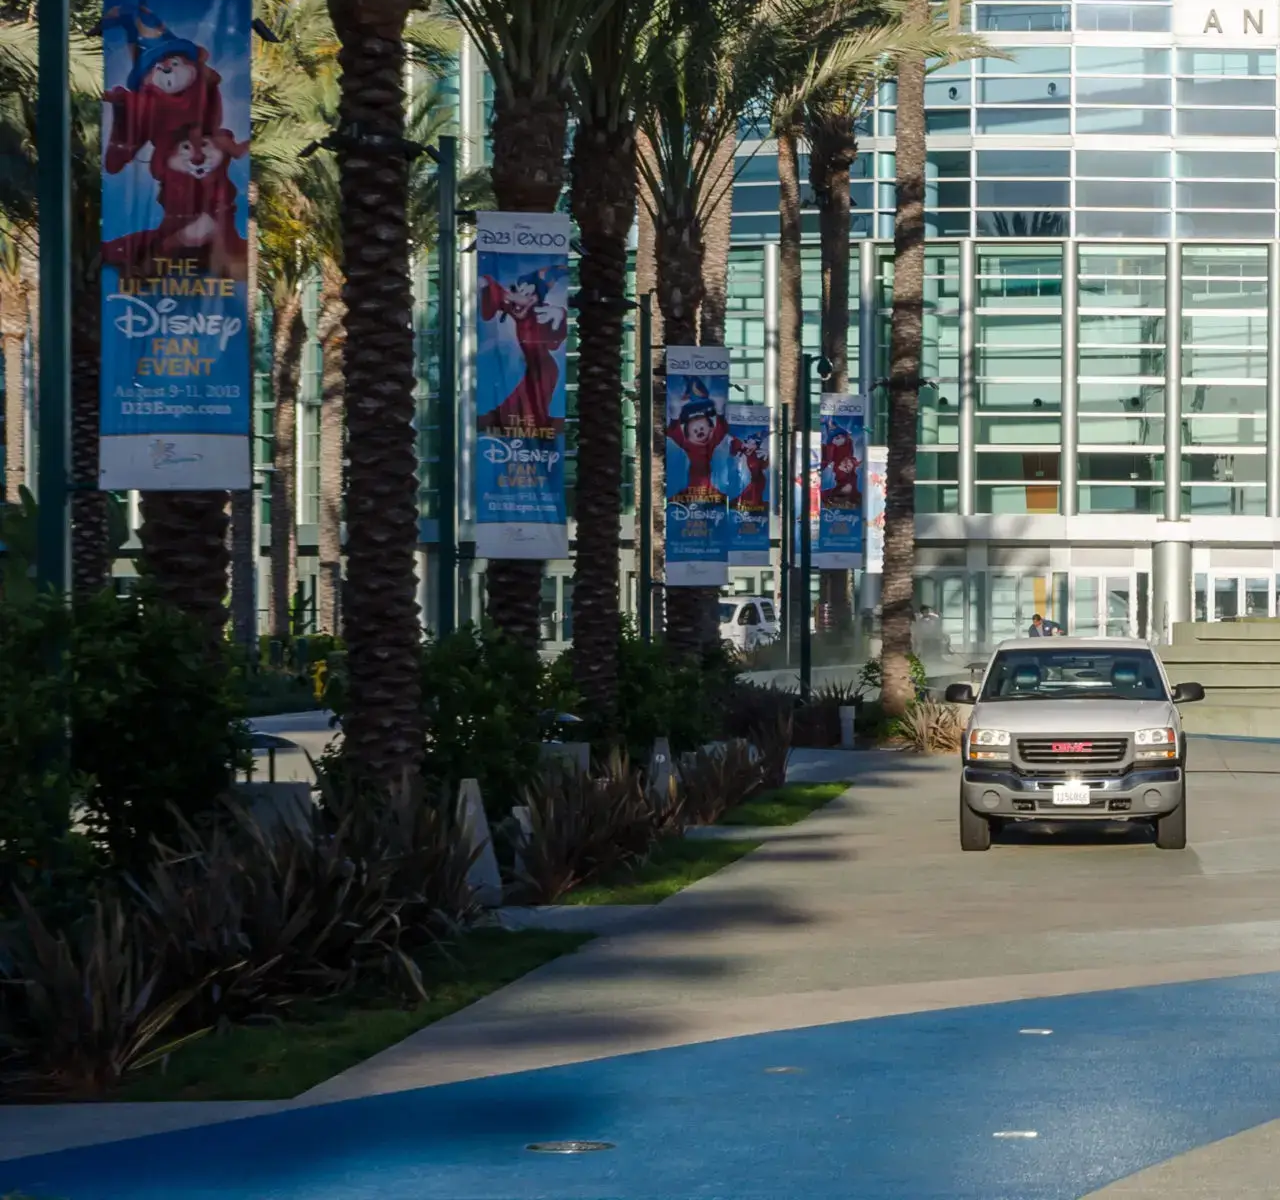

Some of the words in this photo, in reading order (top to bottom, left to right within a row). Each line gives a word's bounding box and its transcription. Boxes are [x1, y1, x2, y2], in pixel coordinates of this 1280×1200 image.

[477, 229, 511, 245] D23
[153, 258, 199, 276] THE
[119, 278, 236, 297] ULTIMATE
[106, 294, 242, 351] Disney
[152, 337, 199, 356] FAN
[136, 357, 216, 377] EVENT
[114, 385, 165, 401] August
[508, 414, 536, 427] THE
[478, 436, 560, 472] Disney
[667, 501, 725, 527] Disney
